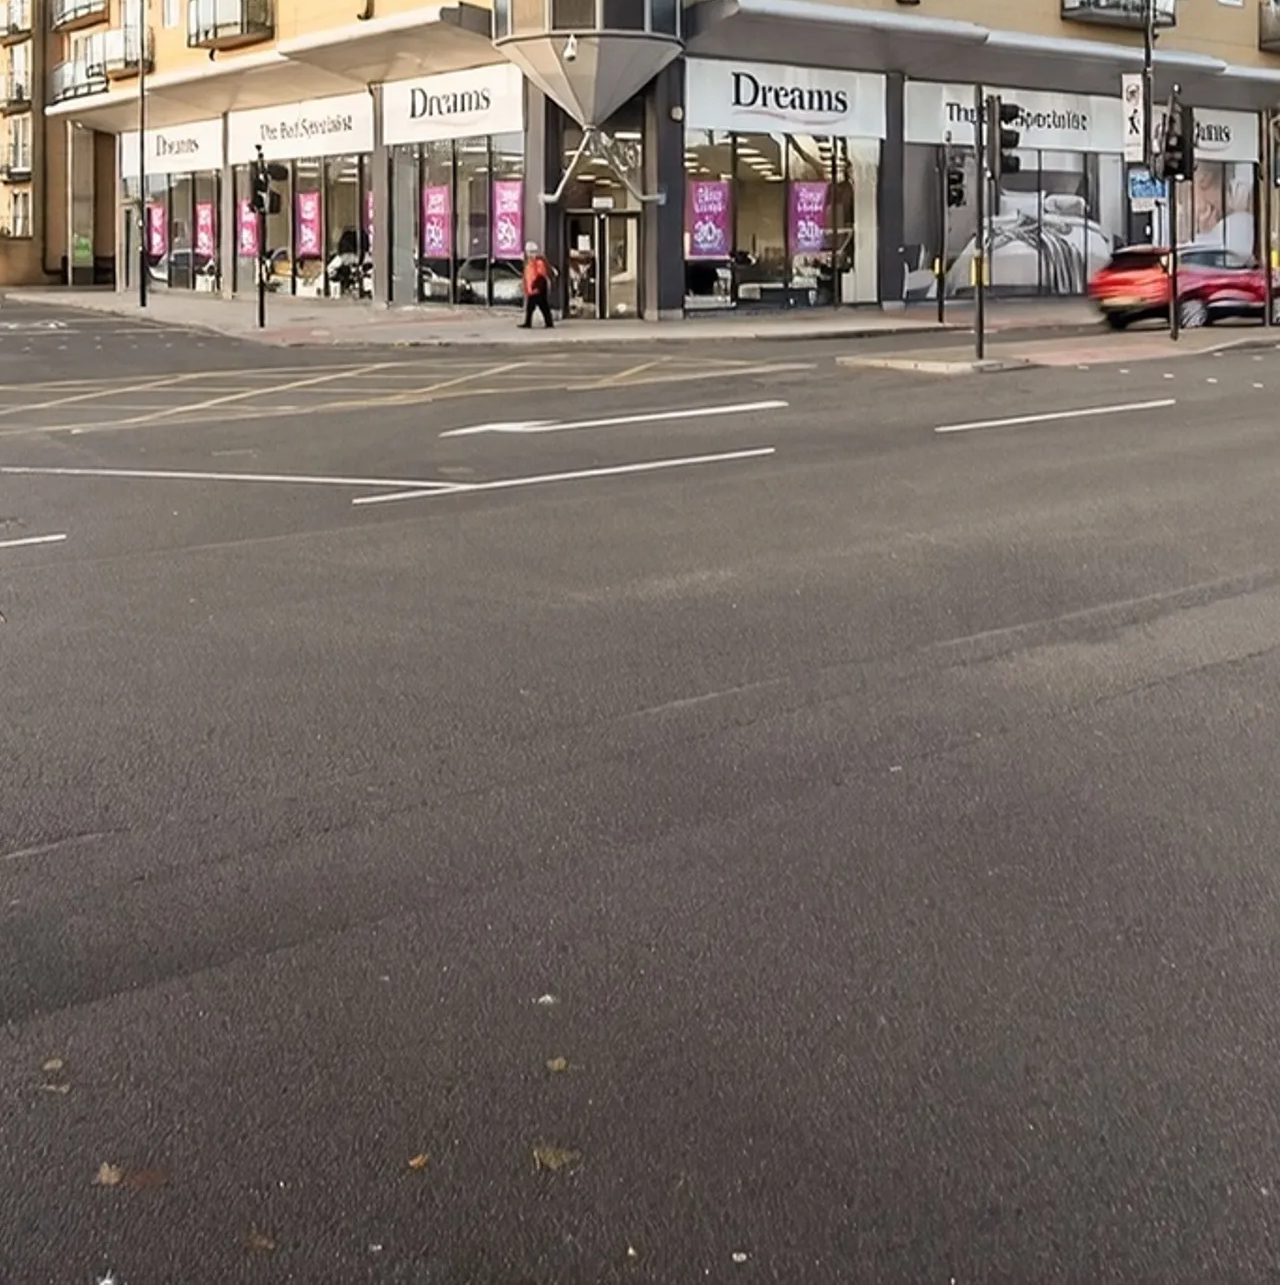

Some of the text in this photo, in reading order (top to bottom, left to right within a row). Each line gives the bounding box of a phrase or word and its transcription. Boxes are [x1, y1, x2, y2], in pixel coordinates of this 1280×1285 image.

[410, 87, 491, 119] Dreams
[731, 71, 848, 113] Dreams
[156, 134, 200, 157] Dreams
